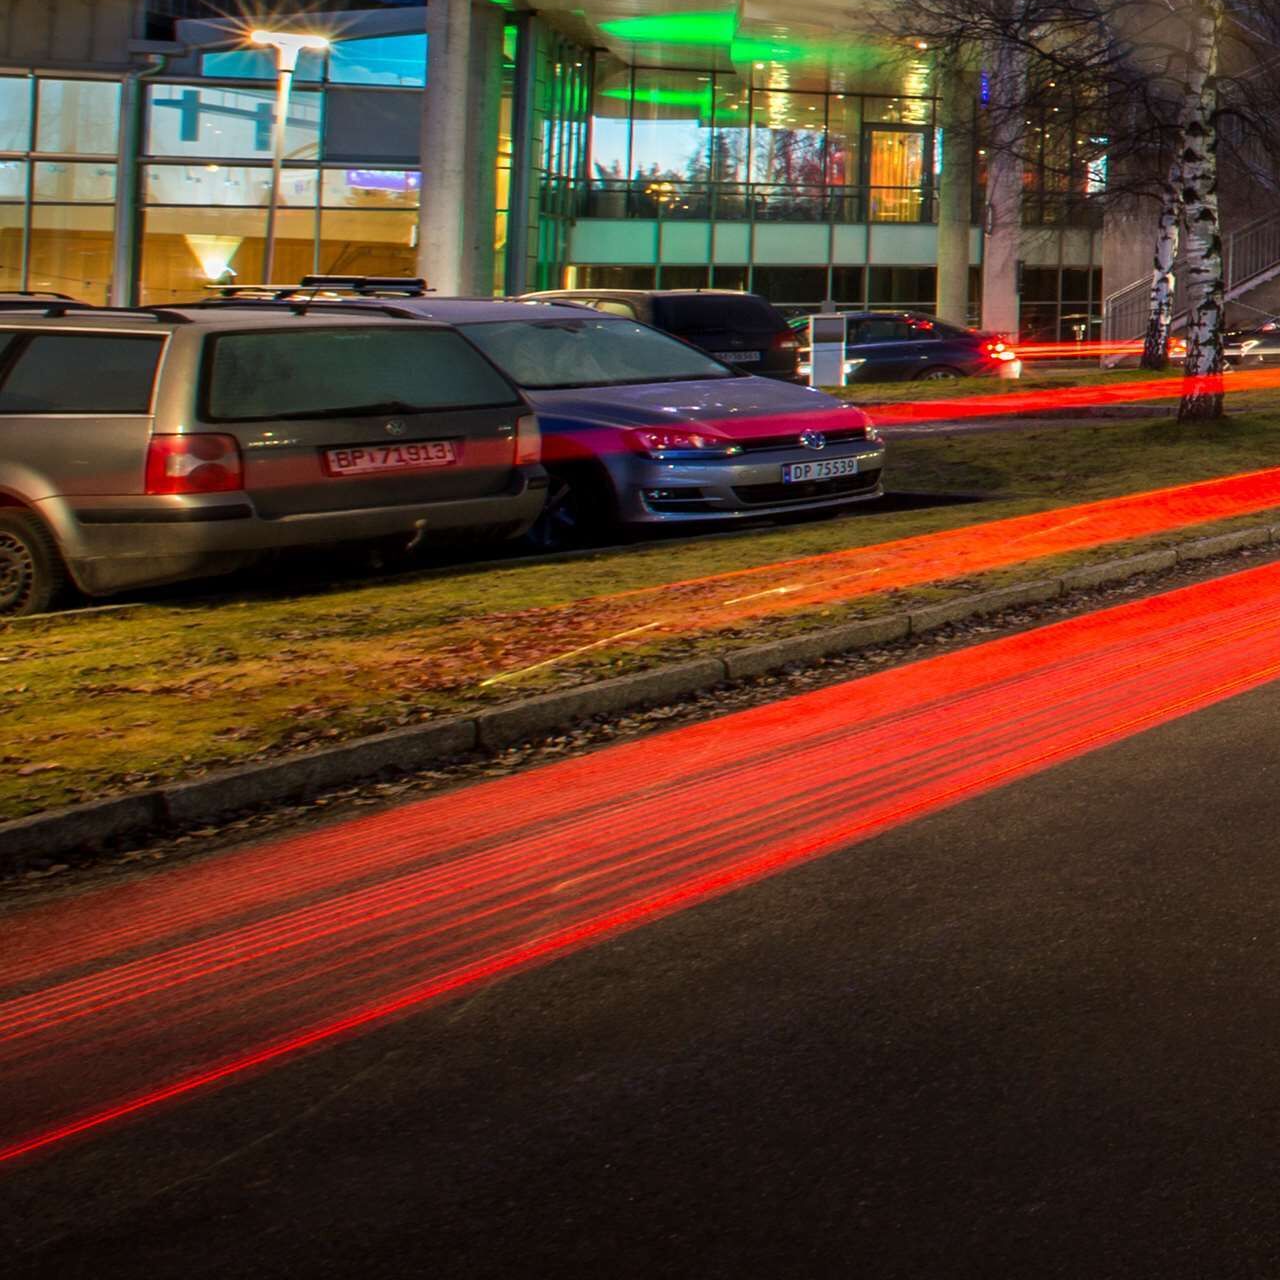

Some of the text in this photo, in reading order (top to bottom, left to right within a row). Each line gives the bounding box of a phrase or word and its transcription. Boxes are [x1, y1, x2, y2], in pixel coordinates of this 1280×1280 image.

[378, 442, 448, 465] 71913
[794, 459, 855, 480] DP 75539
